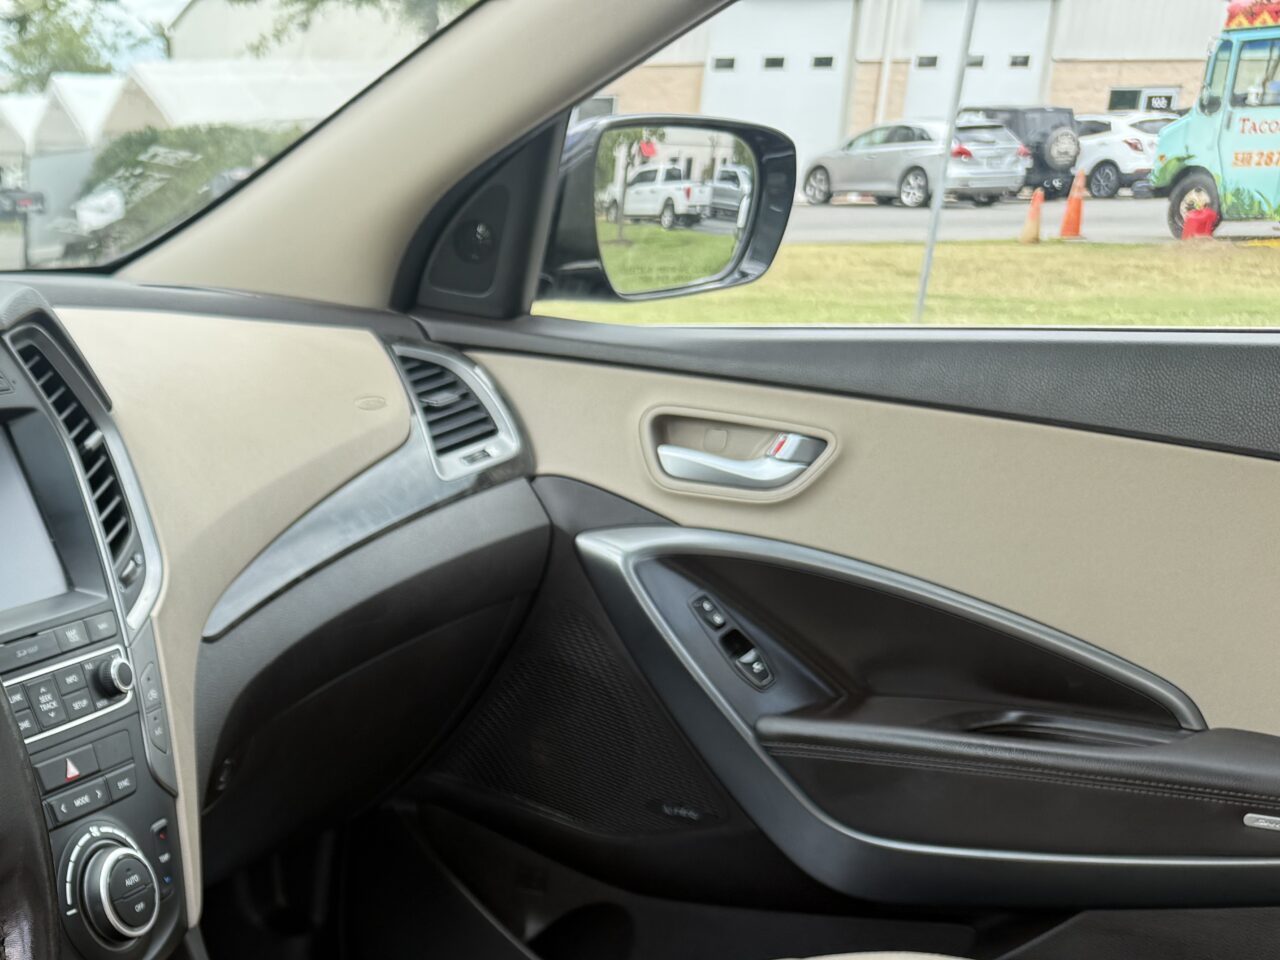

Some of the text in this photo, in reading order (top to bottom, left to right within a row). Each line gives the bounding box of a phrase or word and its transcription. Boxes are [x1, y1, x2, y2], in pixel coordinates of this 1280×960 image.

[1239, 117, 1280, 135] TACO
[72, 699, 88, 710] SETUP
[125, 874, 139, 887] AUTO
